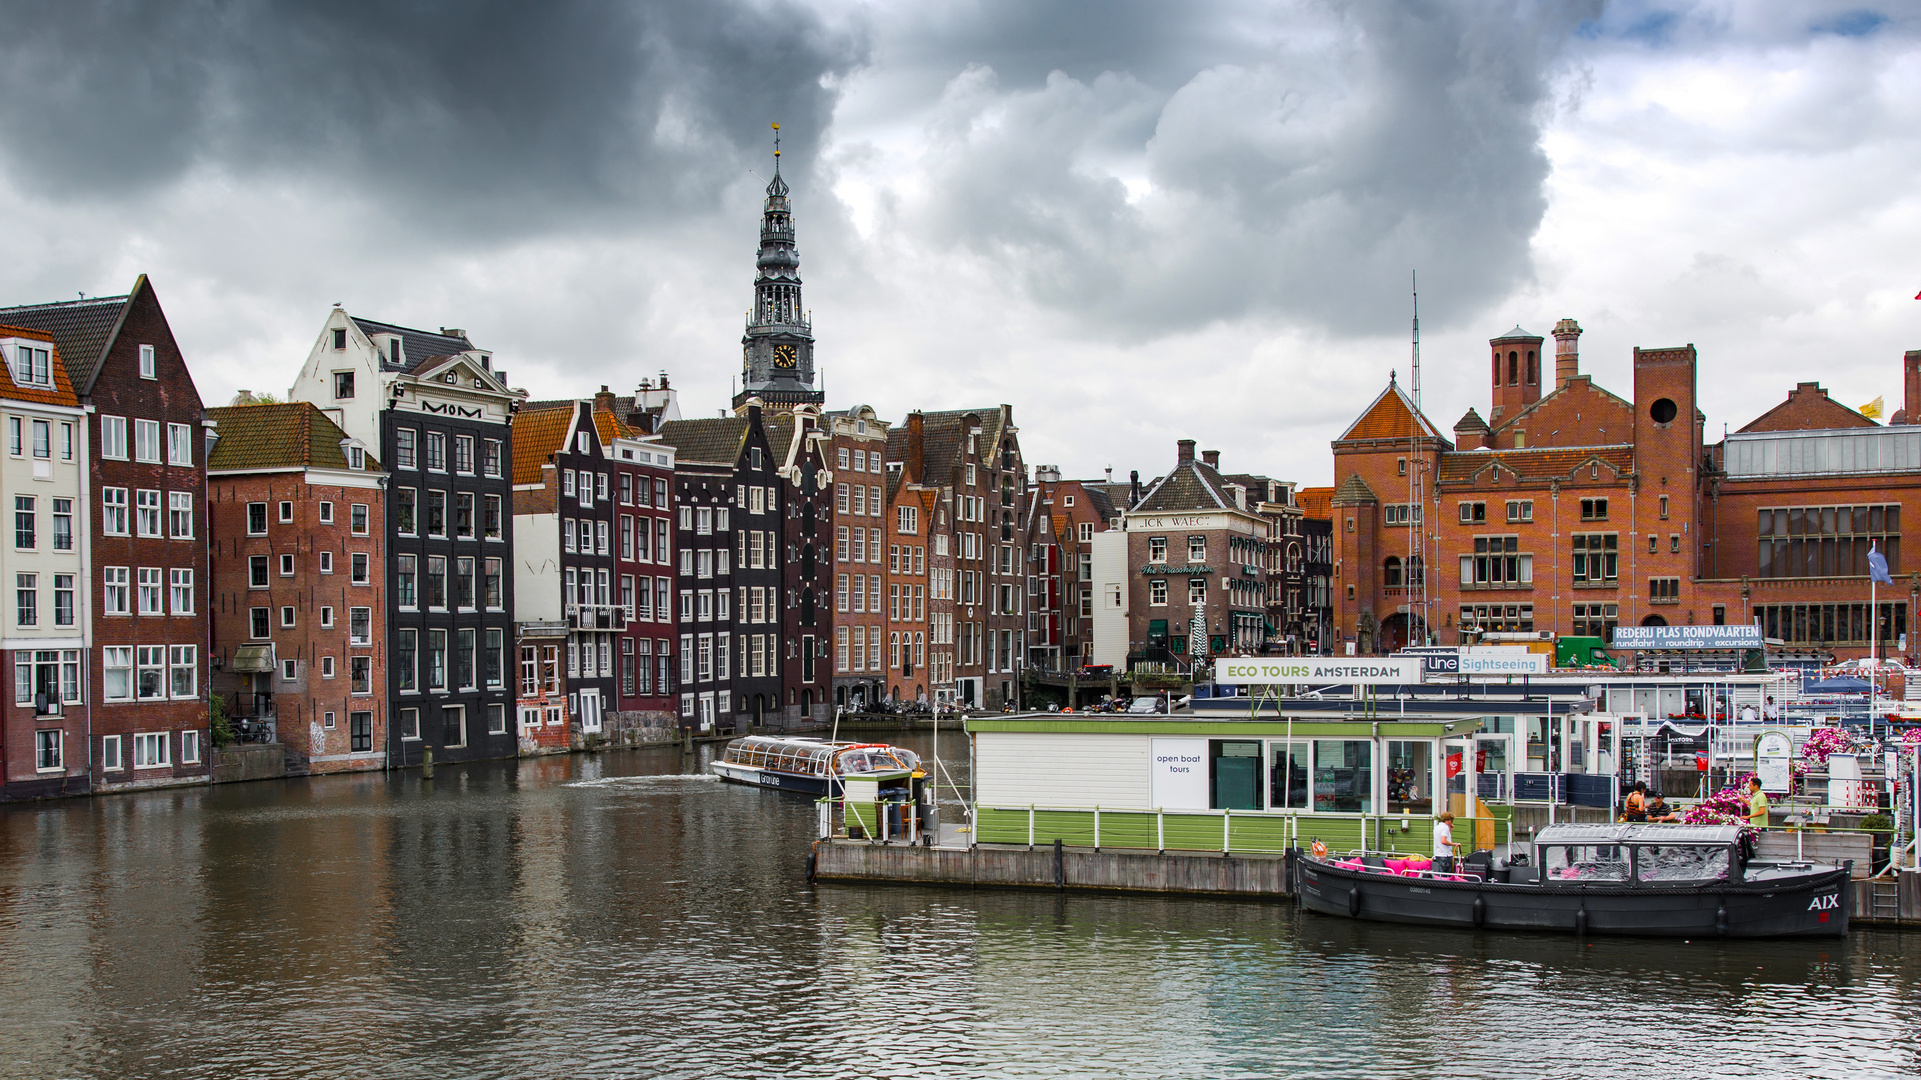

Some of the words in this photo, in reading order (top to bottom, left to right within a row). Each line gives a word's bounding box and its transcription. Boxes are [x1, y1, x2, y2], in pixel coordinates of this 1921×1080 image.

[1140, 564, 1157, 574] The
[1160, 564, 1214, 576] Grasshopper
[1616, 627, 1654, 639] REDERIJ
[1656, 627, 1681, 638] PLAS
[1683, 626, 1759, 638] RONDVAARTEN
[1616, 638, 1655, 647] rundfahrt
[1665, 638, 1705, 648] roundtrip
[1714, 638, 1759, 647] excursions
[1428, 656, 1458, 670] Line
[1462, 658, 1537, 672] Sightseeing
[1228, 666, 1258, 677] ECO
[1261, 666, 1310, 677] TOURS
[1314, 666, 1400, 677] AMSTERDAM
[1156, 755, 1179, 763] open
[1180, 755, 1200, 763] boat
[1169, 765, 1190, 773] tours
[1806, 893, 1840, 911] AIX
